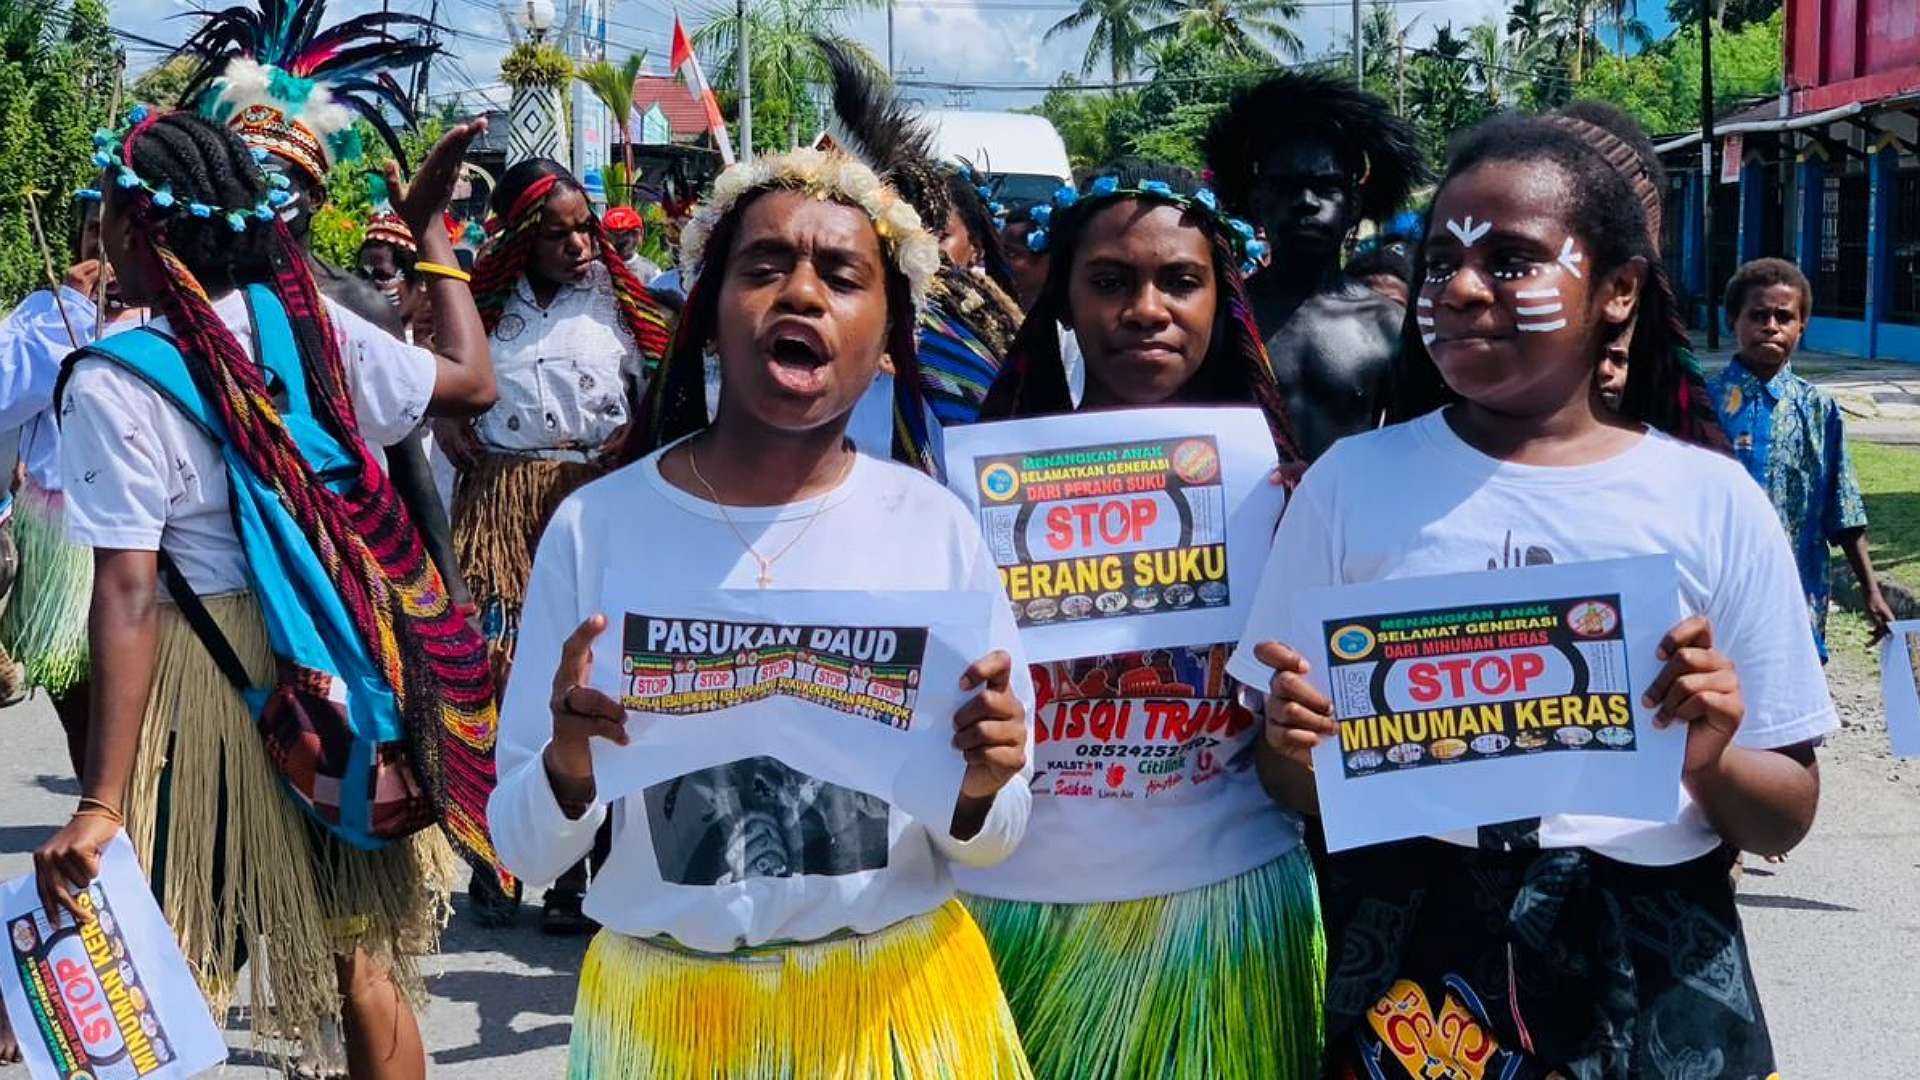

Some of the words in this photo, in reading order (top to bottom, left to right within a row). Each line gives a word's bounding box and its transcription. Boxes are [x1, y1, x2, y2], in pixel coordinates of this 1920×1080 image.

[1020, 465, 1105, 484] SELAMATKAN
[1107, 459, 1170, 475] GENERASI
[1027, 484, 1061, 501] DARI
[1064, 479, 1123, 497] PERANG
[1127, 474, 1167, 491] SUKU
[1044, 498, 1158, 552] STOP
[1133, 545, 1227, 587] SUKU
[1377, 624, 1462, 643] SELAMAT
[1466, 616, 1558, 634] GENERASI
[1380, 609, 1495, 629] MENANGKAN
[1500, 605, 1551, 619] ANAK
[648, 619, 802, 655] PASUKAN
[809, 628, 898, 663] DAUD
[1385, 643, 1418, 659] DARI
[1422, 634, 1495, 656] MINUMAN
[1498, 630, 1549, 647] KERAS
[700, 672, 730, 687] STOP
[762, 661, 790, 678] STOP
[818, 670, 846, 686] STOP
[1408, 652, 1545, 702] STOP
[638, 678, 668, 694] STOP
[873, 686, 901, 701] STOP
[856, 695, 911, 720] MEROKOK
[1340, 702, 1504, 752] MINUMAN
[1514, 694, 1630, 731] KERAS
[78, 892, 114, 968] KERS
[55, 956, 113, 1046] STOP
[100, 968, 160, 1076] MINUMAN
